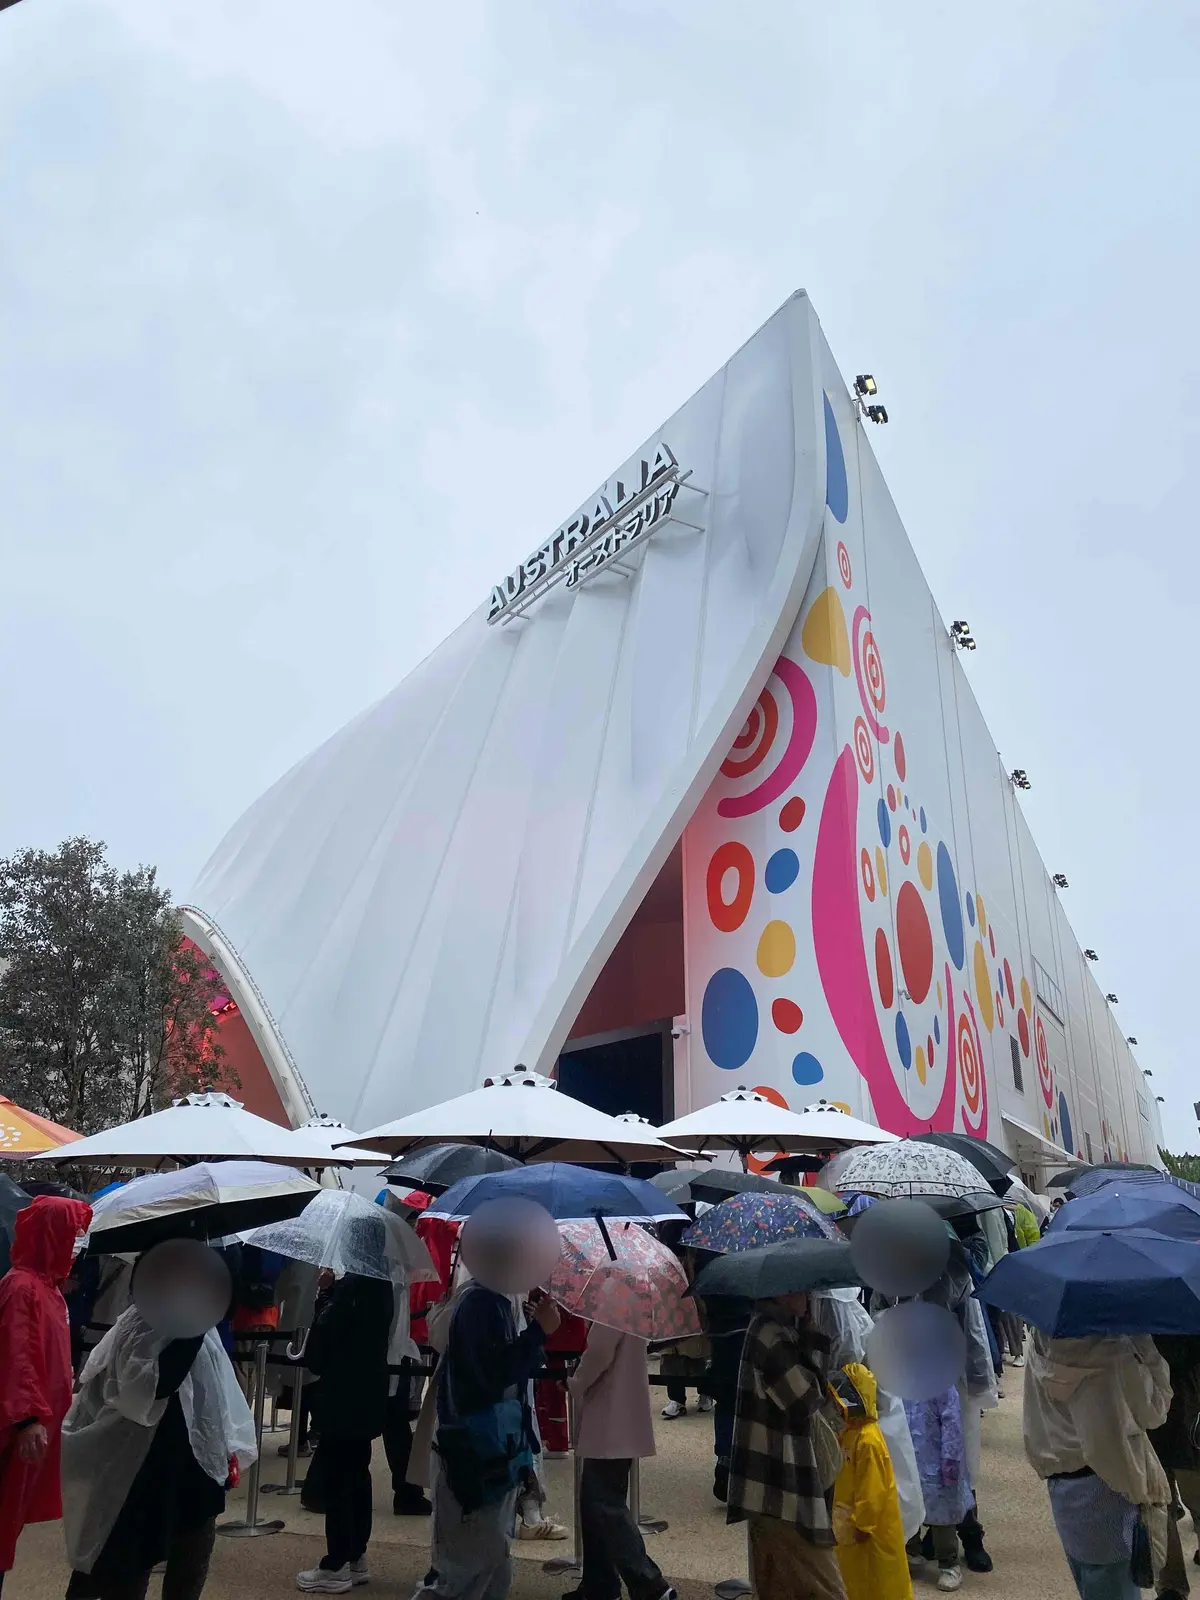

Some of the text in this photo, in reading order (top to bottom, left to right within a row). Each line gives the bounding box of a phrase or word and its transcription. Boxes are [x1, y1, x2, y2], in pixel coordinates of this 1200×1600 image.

[487, 442, 679, 621] AUSTRALIA
[565, 483, 679, 587] オーストラリア
